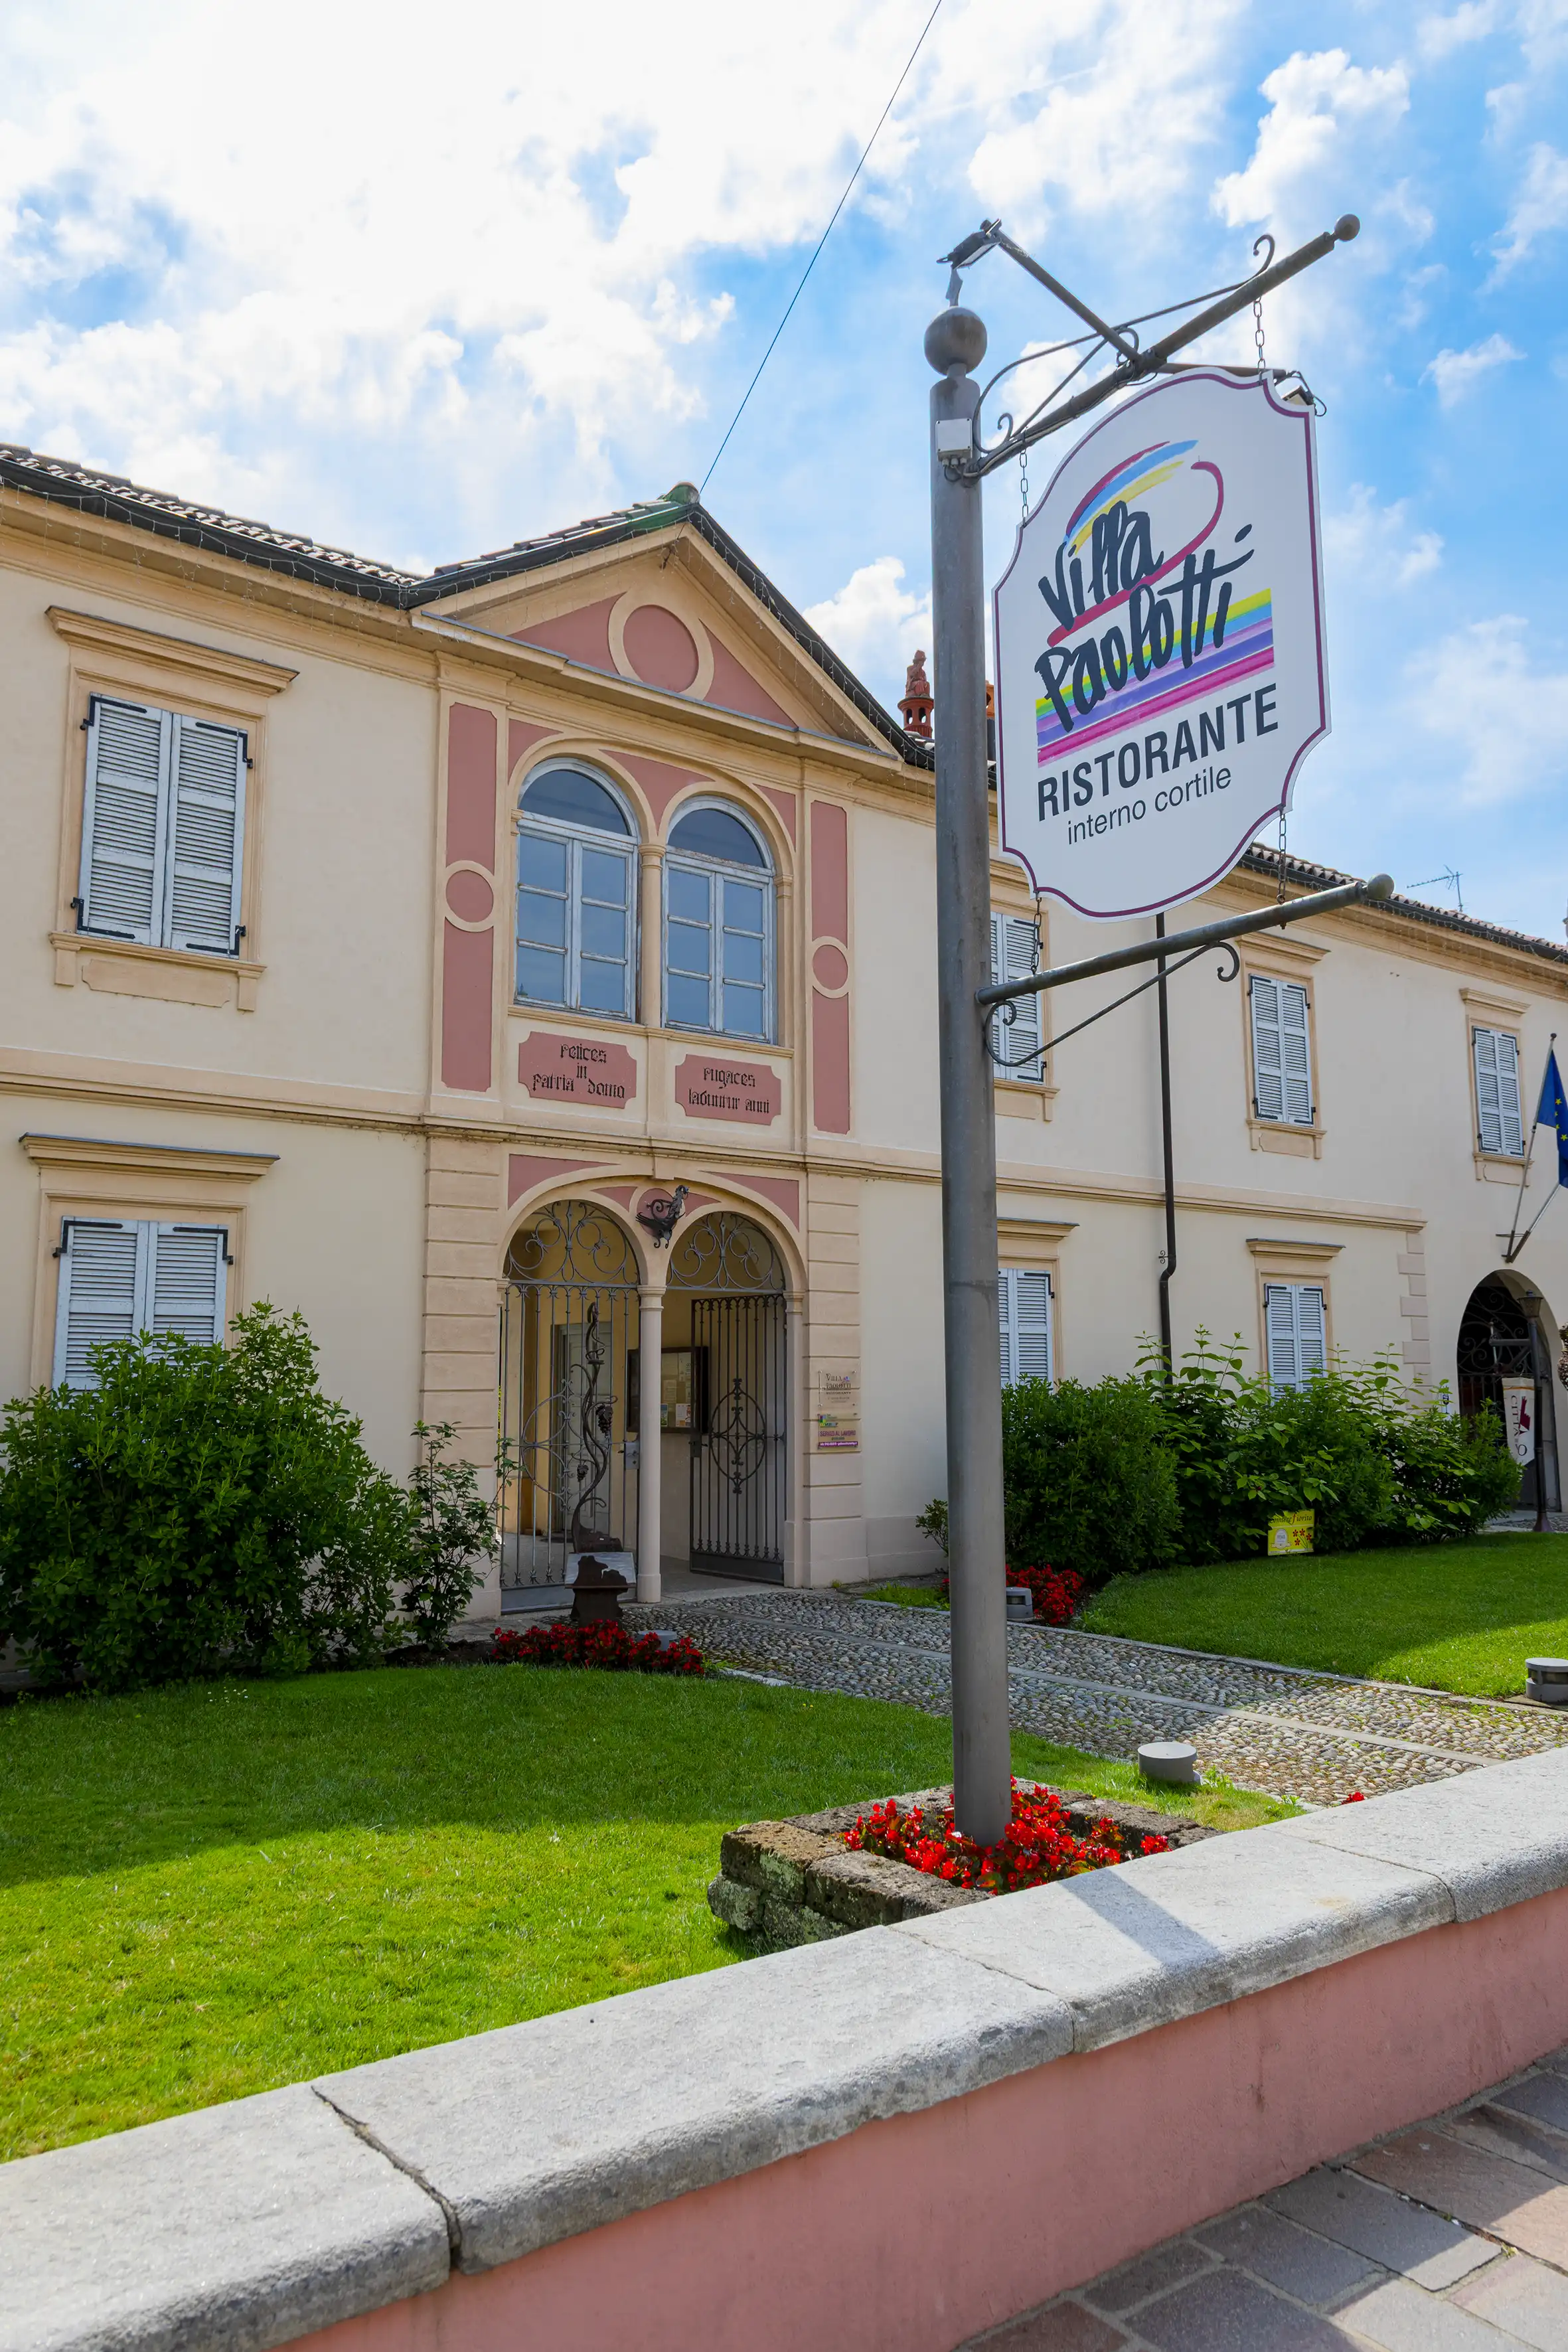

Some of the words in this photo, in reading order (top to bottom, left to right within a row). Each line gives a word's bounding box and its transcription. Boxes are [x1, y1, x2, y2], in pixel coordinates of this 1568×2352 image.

[1034, 524, 1255, 734] Paolotti
[1038, 500, 1164, 631] Villa
[1038, 683, 1279, 822] RISTORANTE
[1067, 798, 1146, 846] interno
[1154, 763, 1232, 813] cortile
[576, 1062, 588, 1079] in
